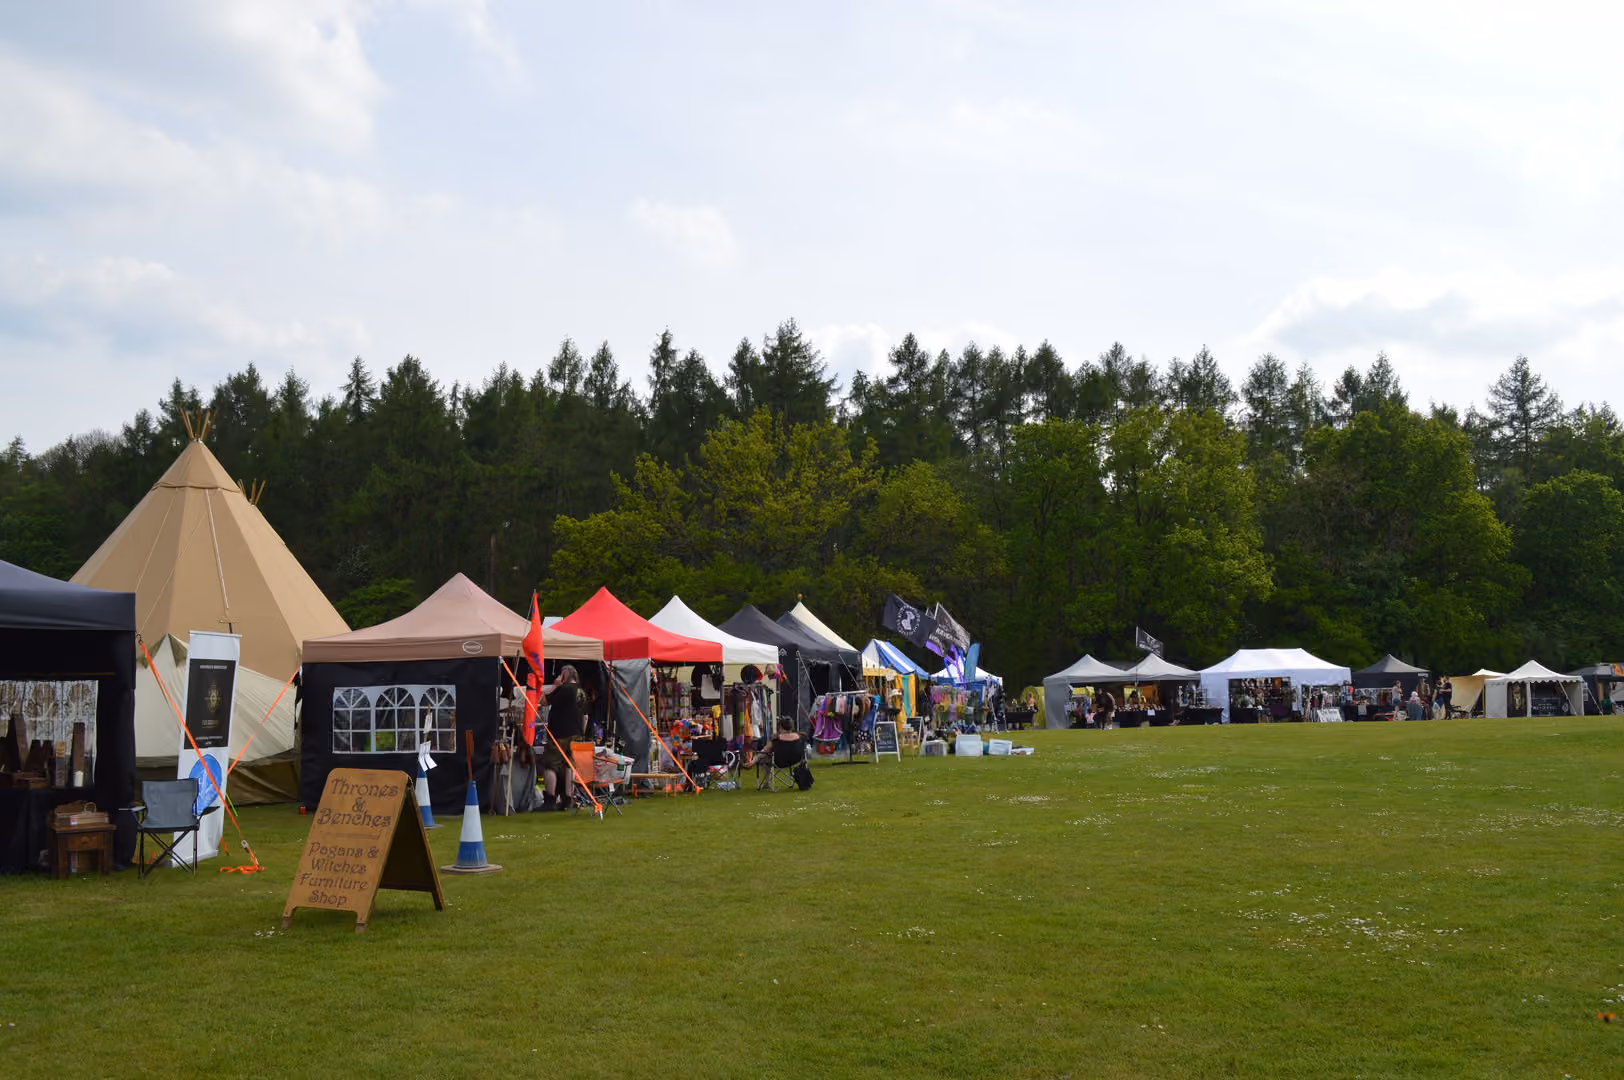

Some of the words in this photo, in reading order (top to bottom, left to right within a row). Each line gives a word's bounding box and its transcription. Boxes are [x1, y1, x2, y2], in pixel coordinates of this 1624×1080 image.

[331, 778, 399, 798] Thrones
[352, 797, 366, 813] &
[317, 808, 392, 828] Benches
[309, 841, 363, 859] Pagans
[367, 846, 380, 858] &
[311, 857, 367, 875] Witches
[300, 872, 369, 892] Furniture
[309, 890, 347, 908] Shop
